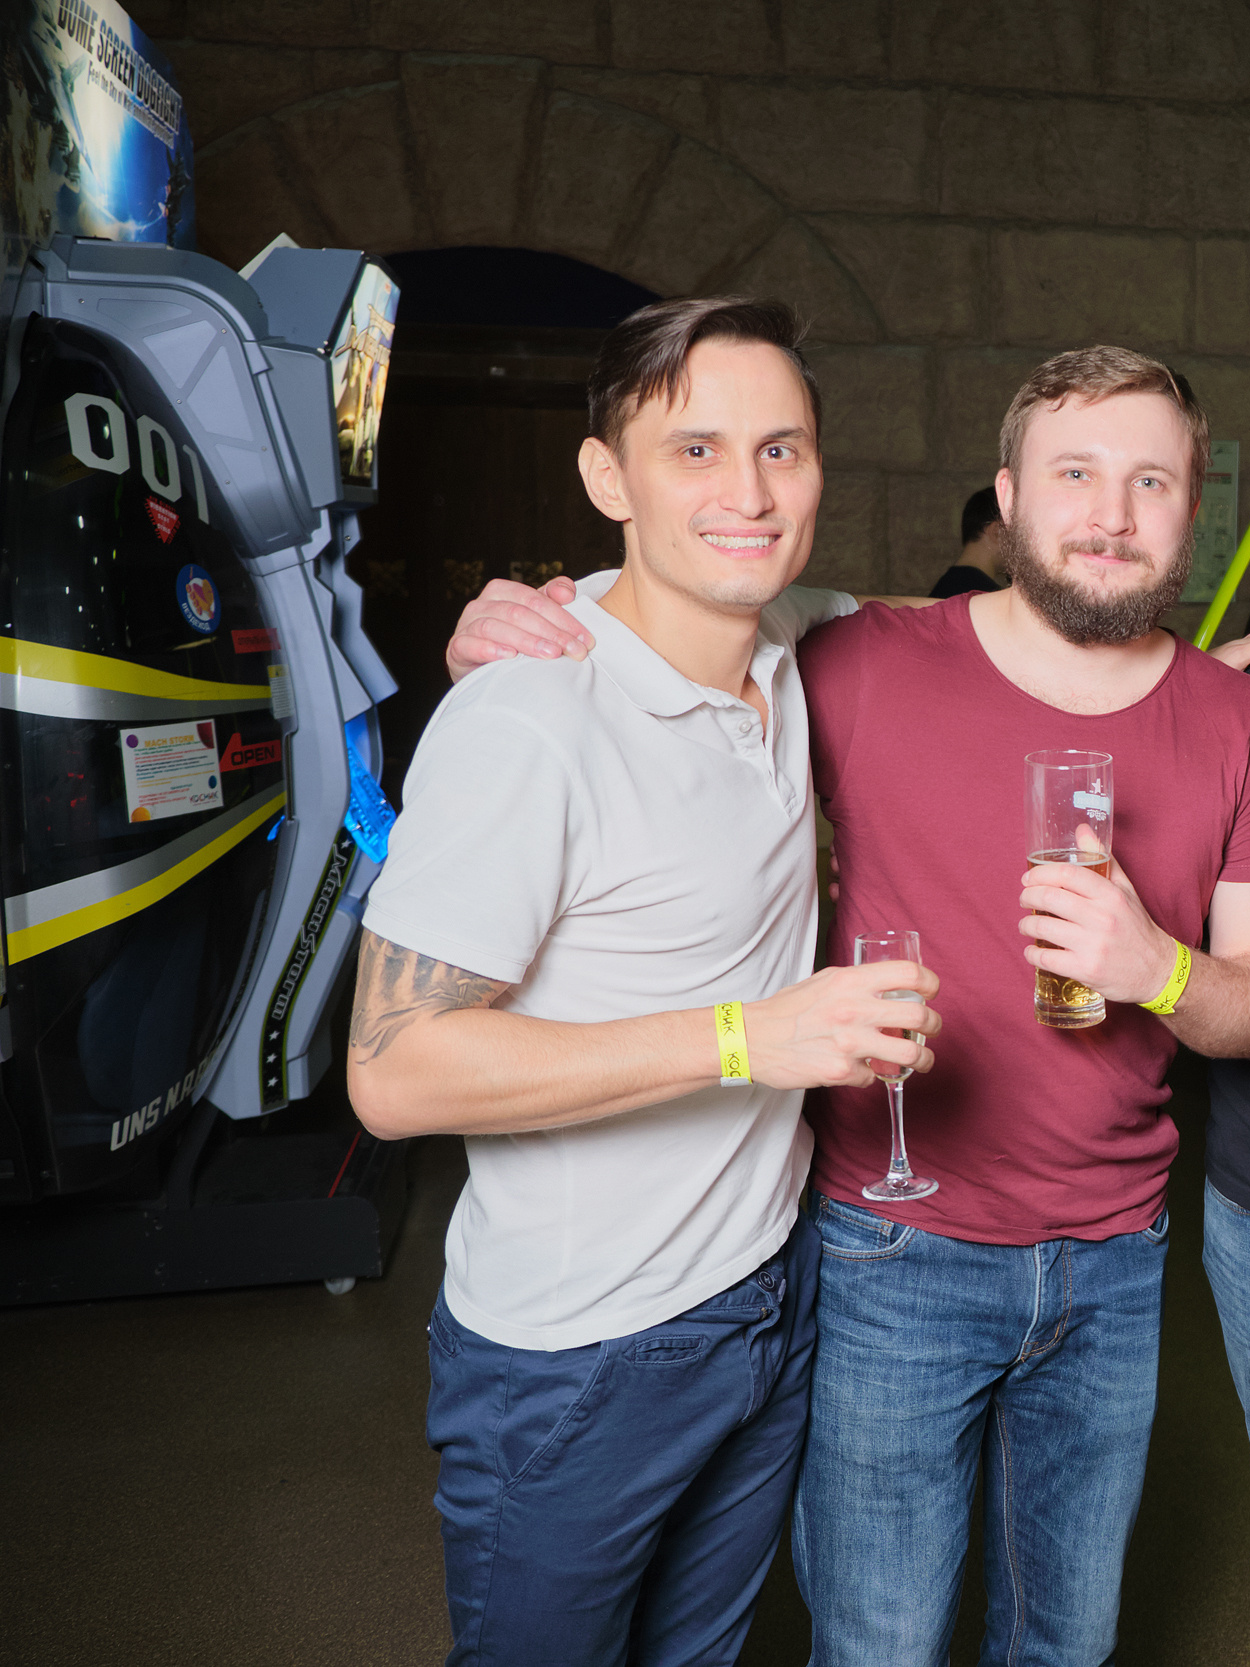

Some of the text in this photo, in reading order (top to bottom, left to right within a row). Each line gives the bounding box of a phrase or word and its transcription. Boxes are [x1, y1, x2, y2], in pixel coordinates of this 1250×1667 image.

[97, 18, 139, 95] SCREEN
[144, 735, 169, 748] MACH
[169, 734, 195, 746] STORM
[230, 744, 275, 767] OPEN
[109, 1095, 163, 1152] UNS
